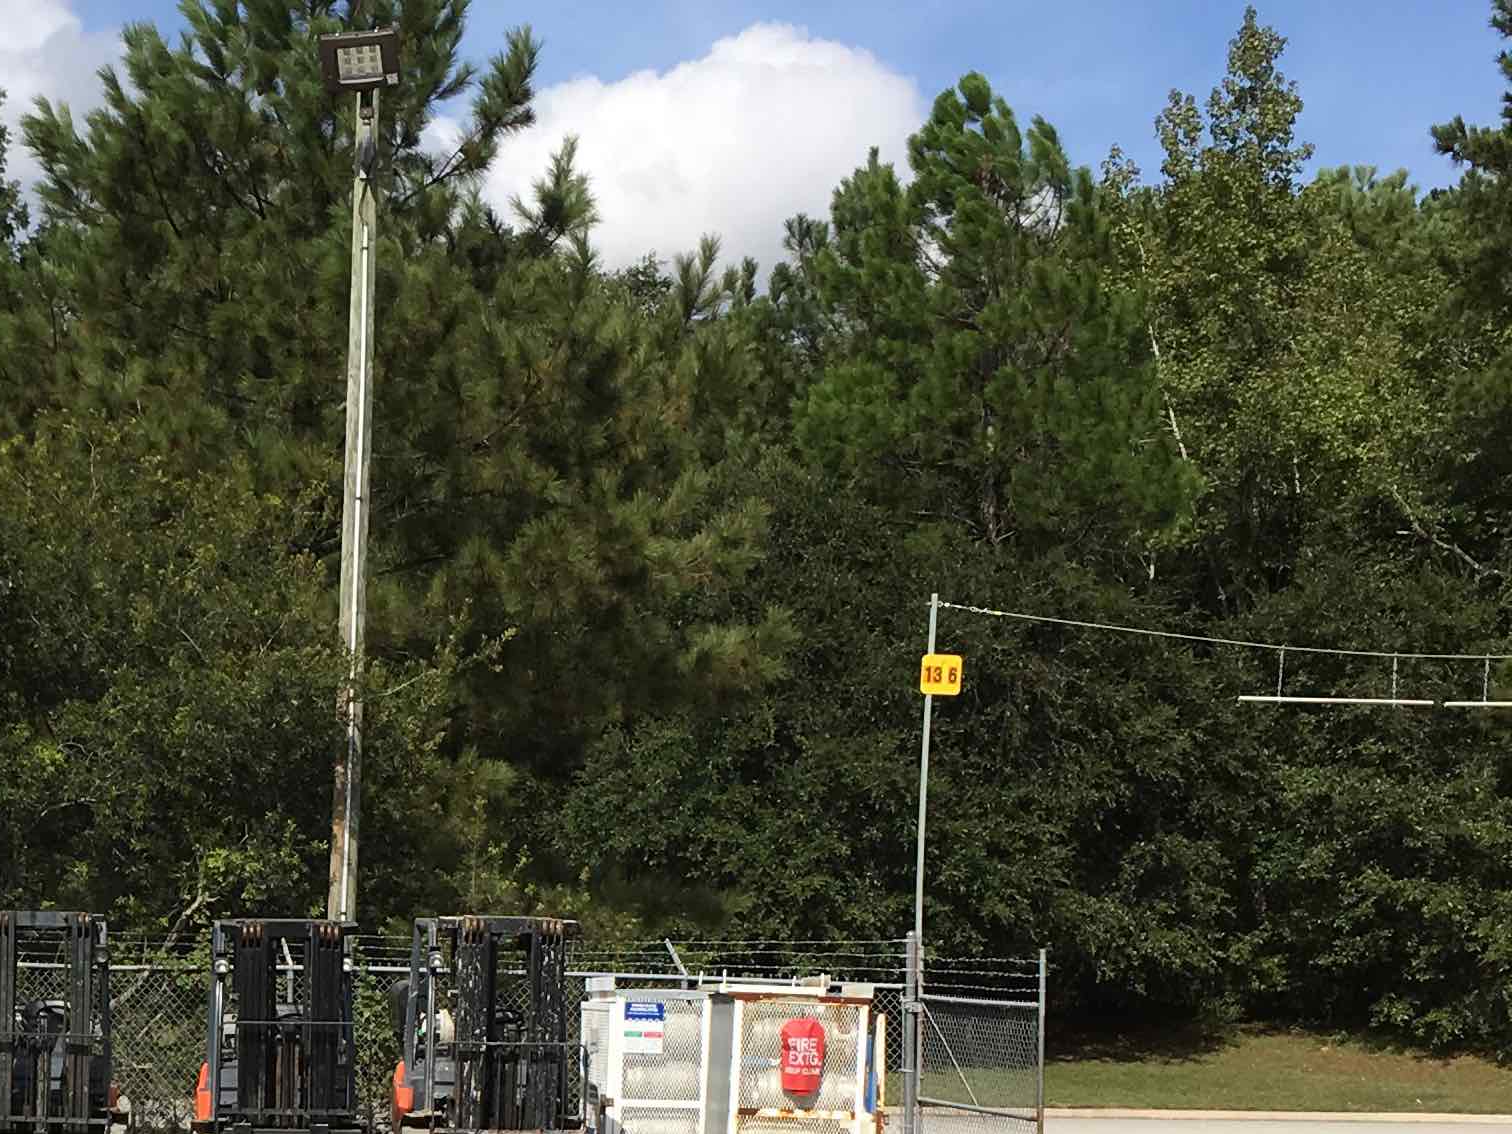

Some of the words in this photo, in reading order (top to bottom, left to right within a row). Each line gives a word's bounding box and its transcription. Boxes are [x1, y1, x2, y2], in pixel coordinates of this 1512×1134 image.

[926, 666, 942, 682] 13
[949, 666, 958, 684] 6
[788, 1037, 817, 1052] FIRE
